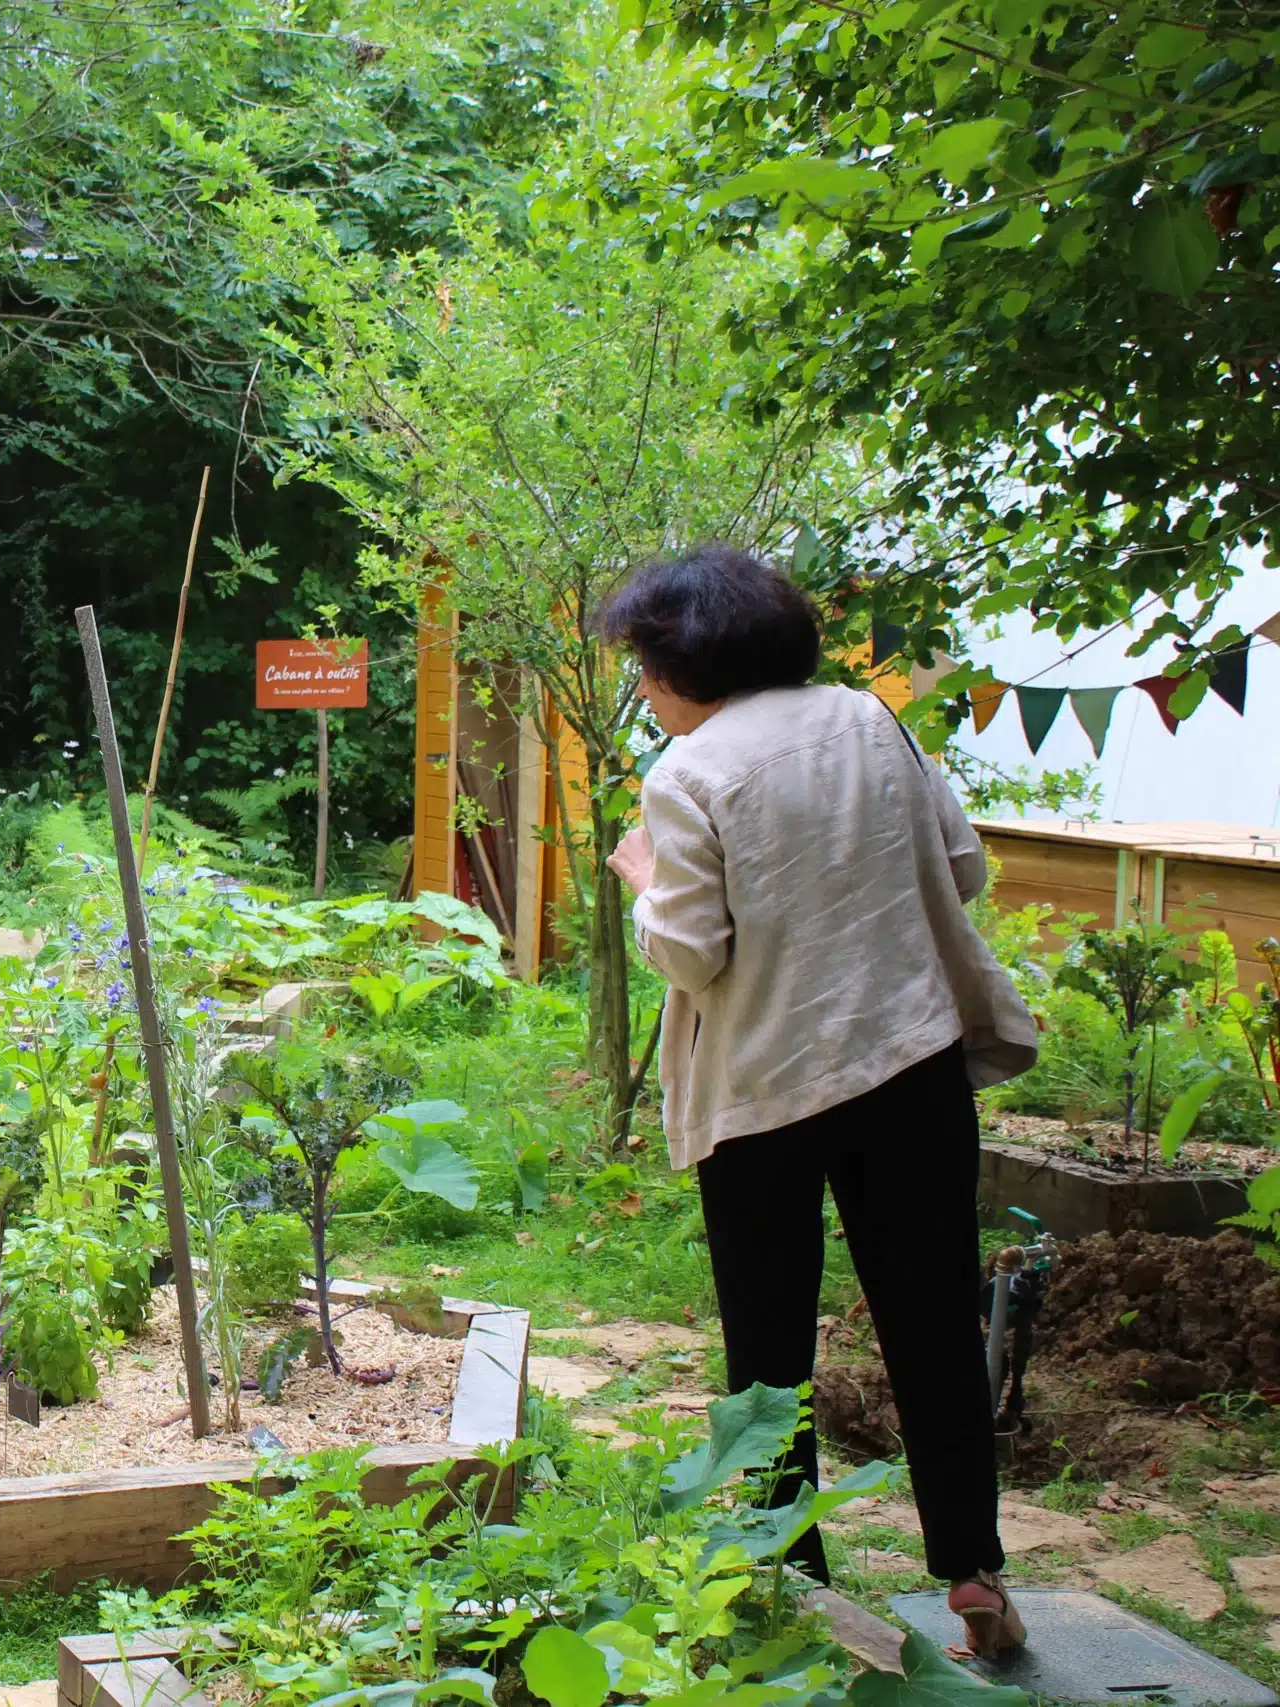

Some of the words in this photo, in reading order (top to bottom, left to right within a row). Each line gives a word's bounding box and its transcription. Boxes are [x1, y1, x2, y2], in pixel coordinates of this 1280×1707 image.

[265, 665, 312, 683] Cabane
[314, 665, 324, 680] à
[327, 667, 360, 680] outils
